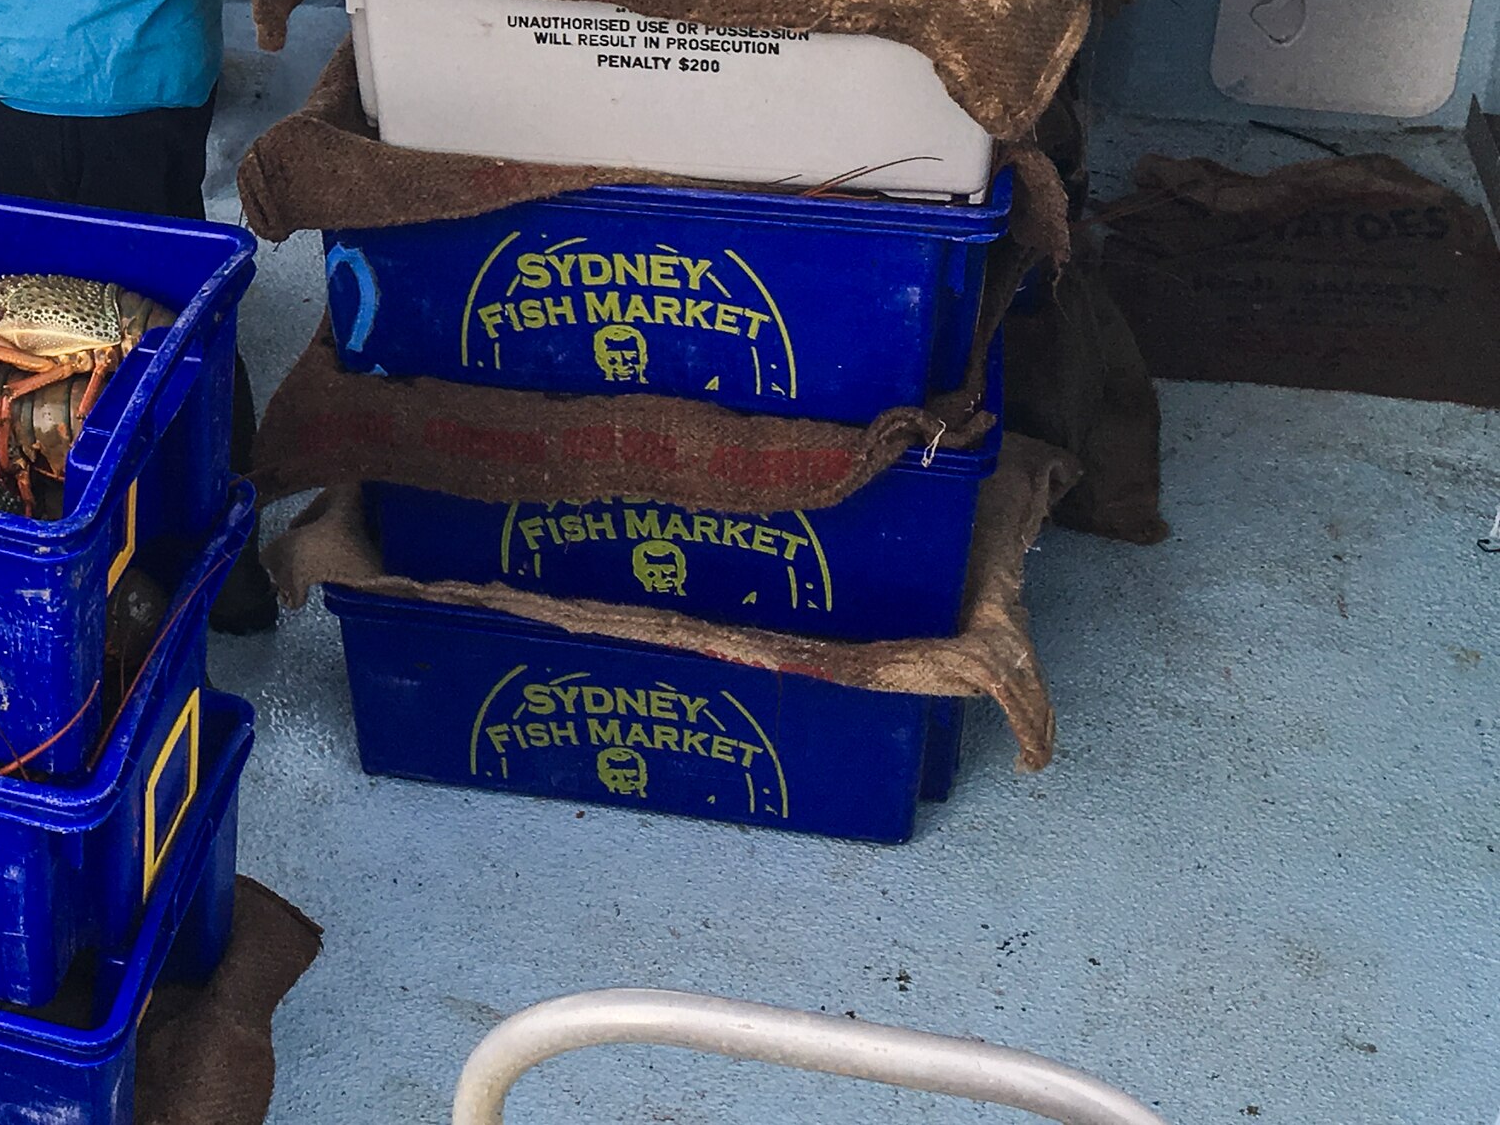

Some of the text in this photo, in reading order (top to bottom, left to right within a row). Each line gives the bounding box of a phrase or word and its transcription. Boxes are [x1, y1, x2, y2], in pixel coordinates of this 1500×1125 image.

[507, 15, 630, 32] UNAUTHORISED
[637, 20, 669, 34] USE
[676, 22, 698, 36] OR
[534, 32, 780, 55] WILL RESULT IN PROSECUTION
[597, 54, 720, 73] PENALTY $200
[516, 252, 712, 291] SYDNEY
[477, 291, 771, 341] FISH MARKET
[518, 509, 809, 560] FISH MARKET
[523, 683, 709, 723] SYDNEY
[486, 718, 763, 768] FISH MARKET
